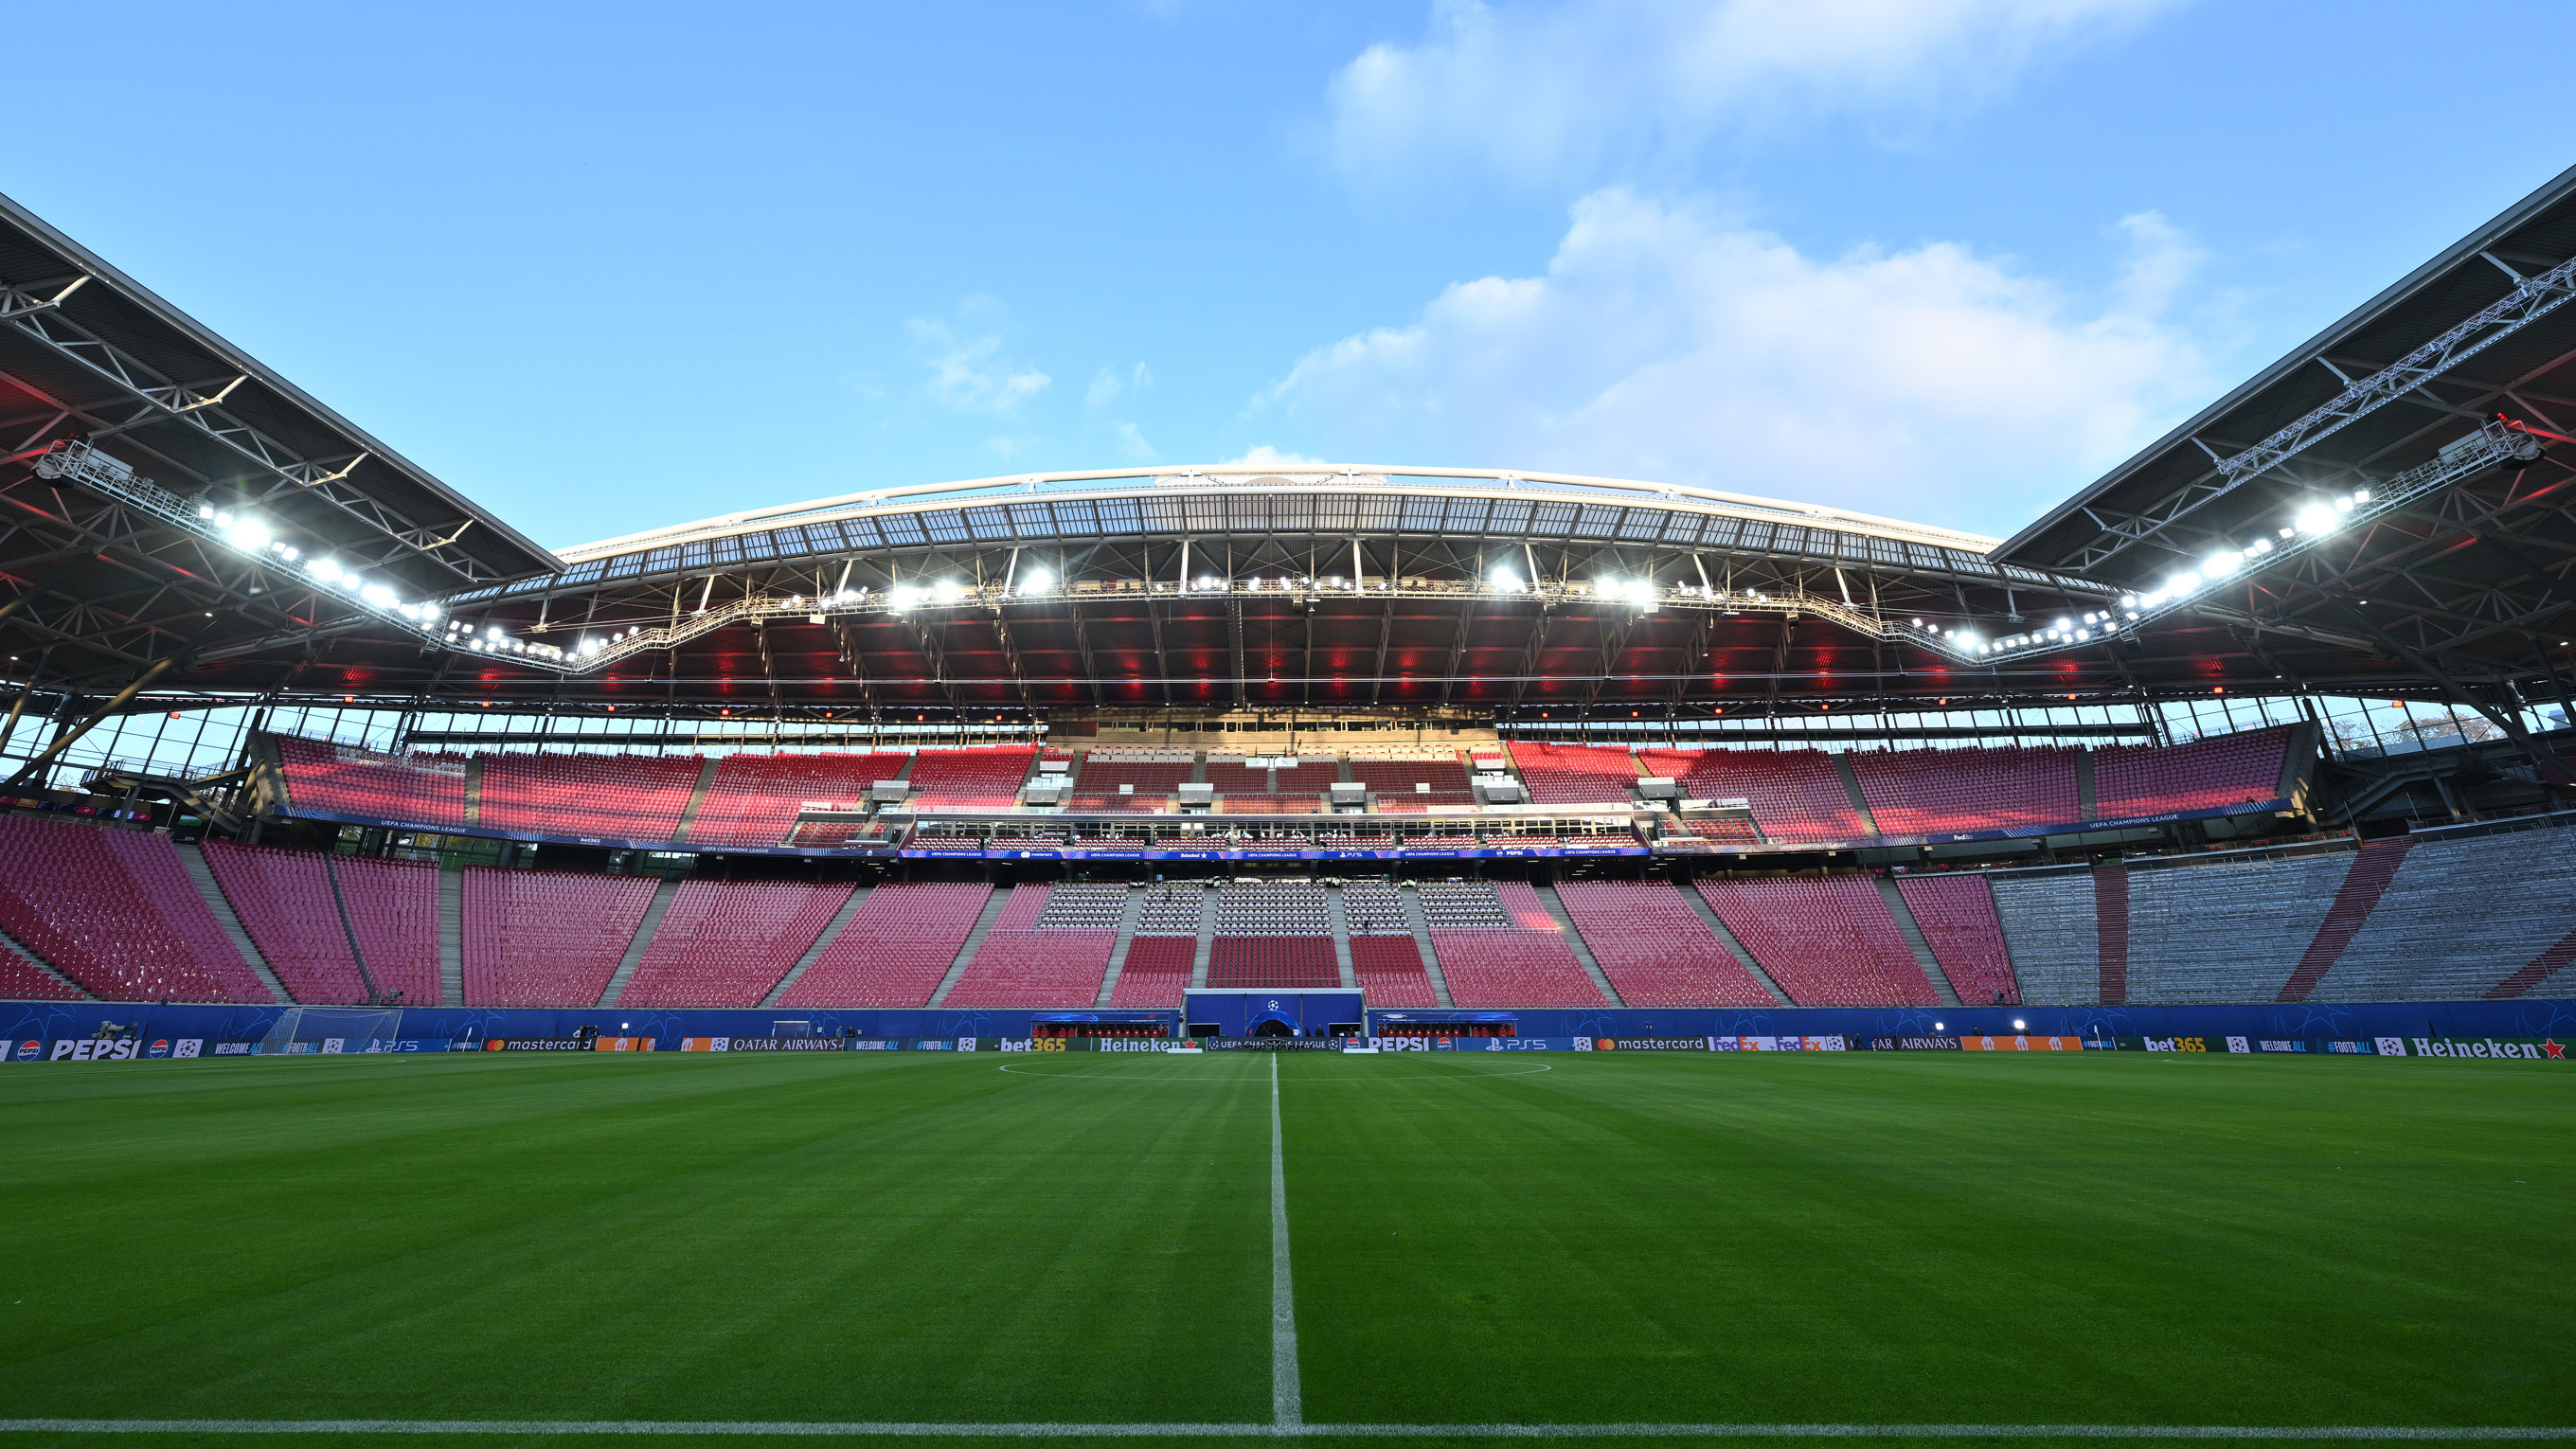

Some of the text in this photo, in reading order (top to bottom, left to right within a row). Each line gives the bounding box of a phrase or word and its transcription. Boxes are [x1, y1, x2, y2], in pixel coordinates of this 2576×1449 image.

[401, 822, 439, 831] CHAMPIONS
[2109, 817, 2150, 827] CHAMPIONS
[2151, 814, 2178, 822] LEAGUE
[214, 1043, 265, 1055] WELCOME ALL
[384, 1041, 419, 1051] PS5
[734, 1039, 838, 1051] QATAR AIRWAYS
[856, 1041, 899, 1050] WELCOME ALL
[917, 1041, 953, 1050] #FOOTBALL
[1000, 1037, 1066, 1052] bet365
[1100, 1037, 1181, 1052] Heineken
[1368, 1037, 1429, 1051] PEPSI
[1507, 1039, 1547, 1050] PS5
[1619, 1037, 1704, 1049] mastercard
[1712, 1036, 1762, 1051] FedEx
[1775, 1036, 1823, 1051] FedEx
[1901, 1038, 1958, 1049] AIRWAYS
[2143, 1036, 2207, 1052] bet365
[2259, 1040, 2307, 1052] WELCOME ALL
[2327, 1041, 2372, 1054] #FOOTBALL
[2411, 1037, 2542, 1059] Heineken
[49, 1039, 142, 1061] PEPSI
